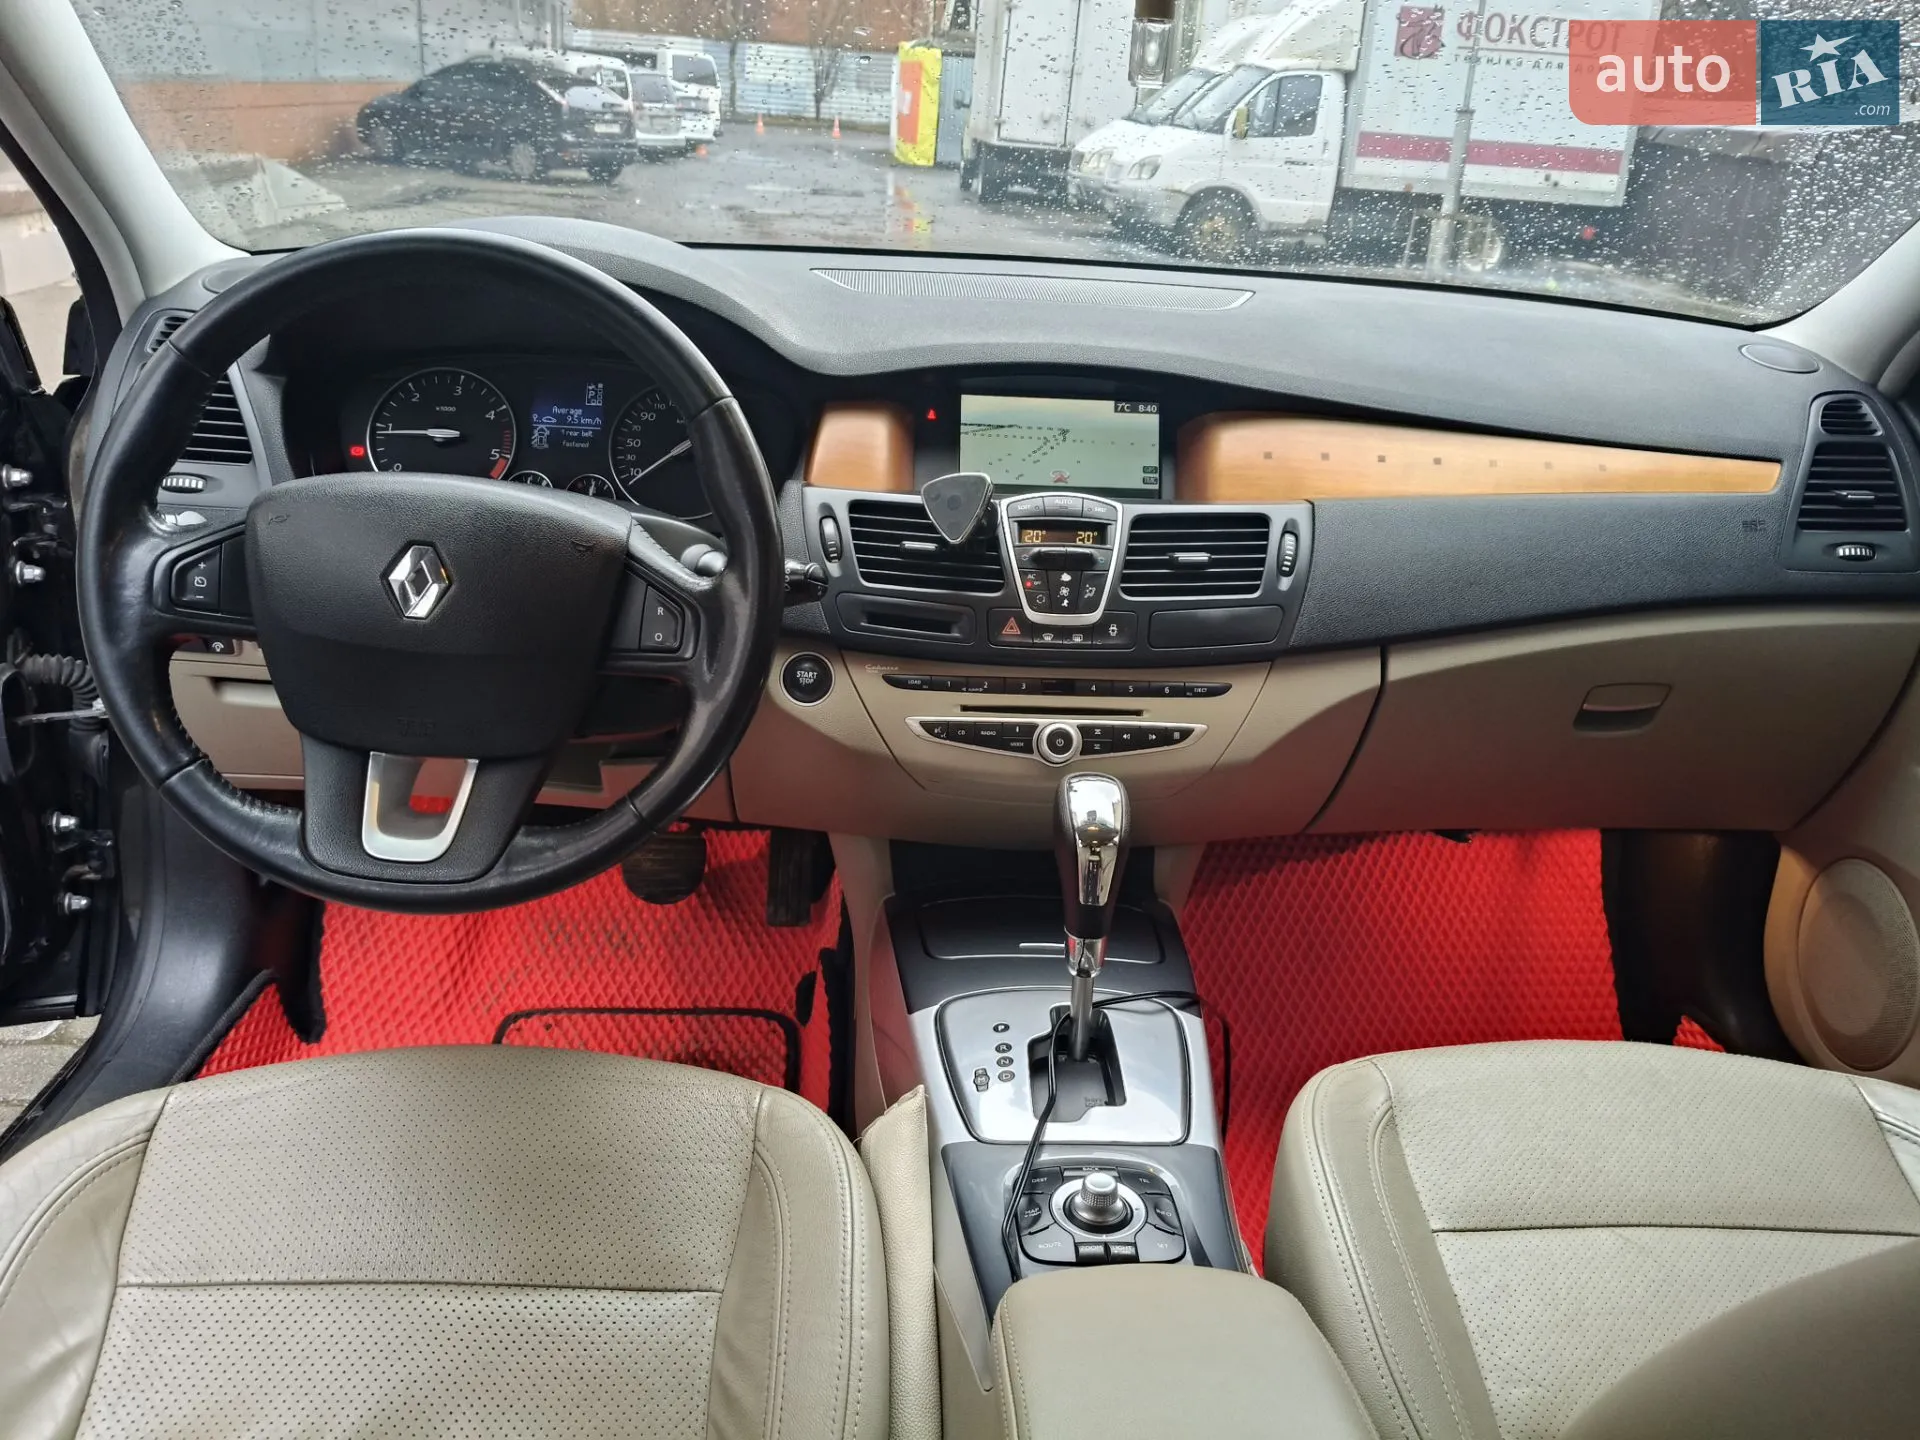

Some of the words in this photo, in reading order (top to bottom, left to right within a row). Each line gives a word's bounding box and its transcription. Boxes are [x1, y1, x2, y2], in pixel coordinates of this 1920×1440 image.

[1456, 11, 1627, 53] ФОКСТРОТ
[454, 386, 462, 396] 3
[411, 393, 420, 402] 2
[1138, 404, 1158, 412] 8:40
[485, 410, 496, 420] 4
[640, 412, 656, 420] 90
[626, 438, 641, 448] 50
[489, 448, 500, 460] 5
[630, 468, 642, 476] 10
[658, 606, 664, 616] R
[796, 670, 818, 679] START
[984, 681, 988, 689] 2
